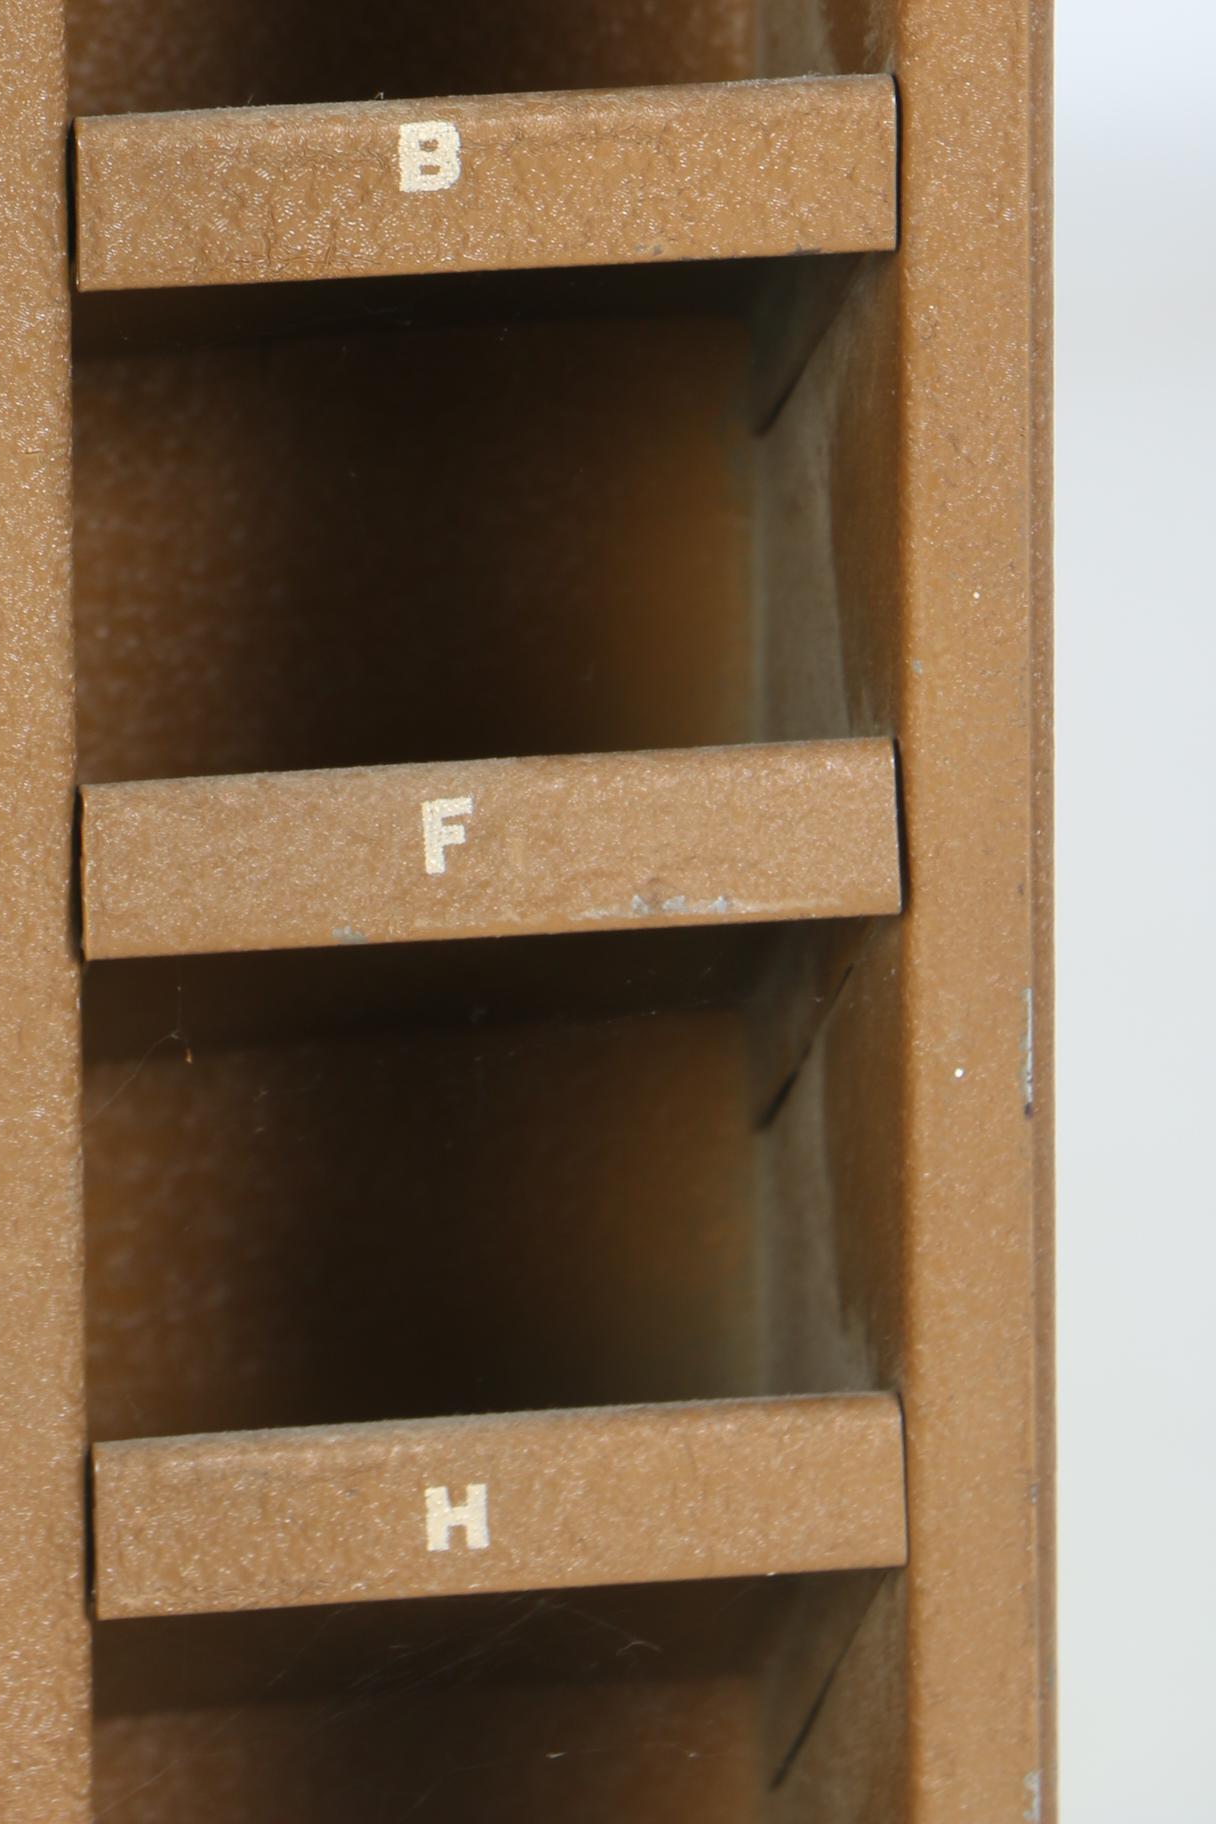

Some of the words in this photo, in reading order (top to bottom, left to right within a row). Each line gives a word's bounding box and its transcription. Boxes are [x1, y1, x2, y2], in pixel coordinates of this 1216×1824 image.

[398, 119, 462, 194] B
[421, 792, 475, 875] F
[424, 1483, 491, 1552] H
